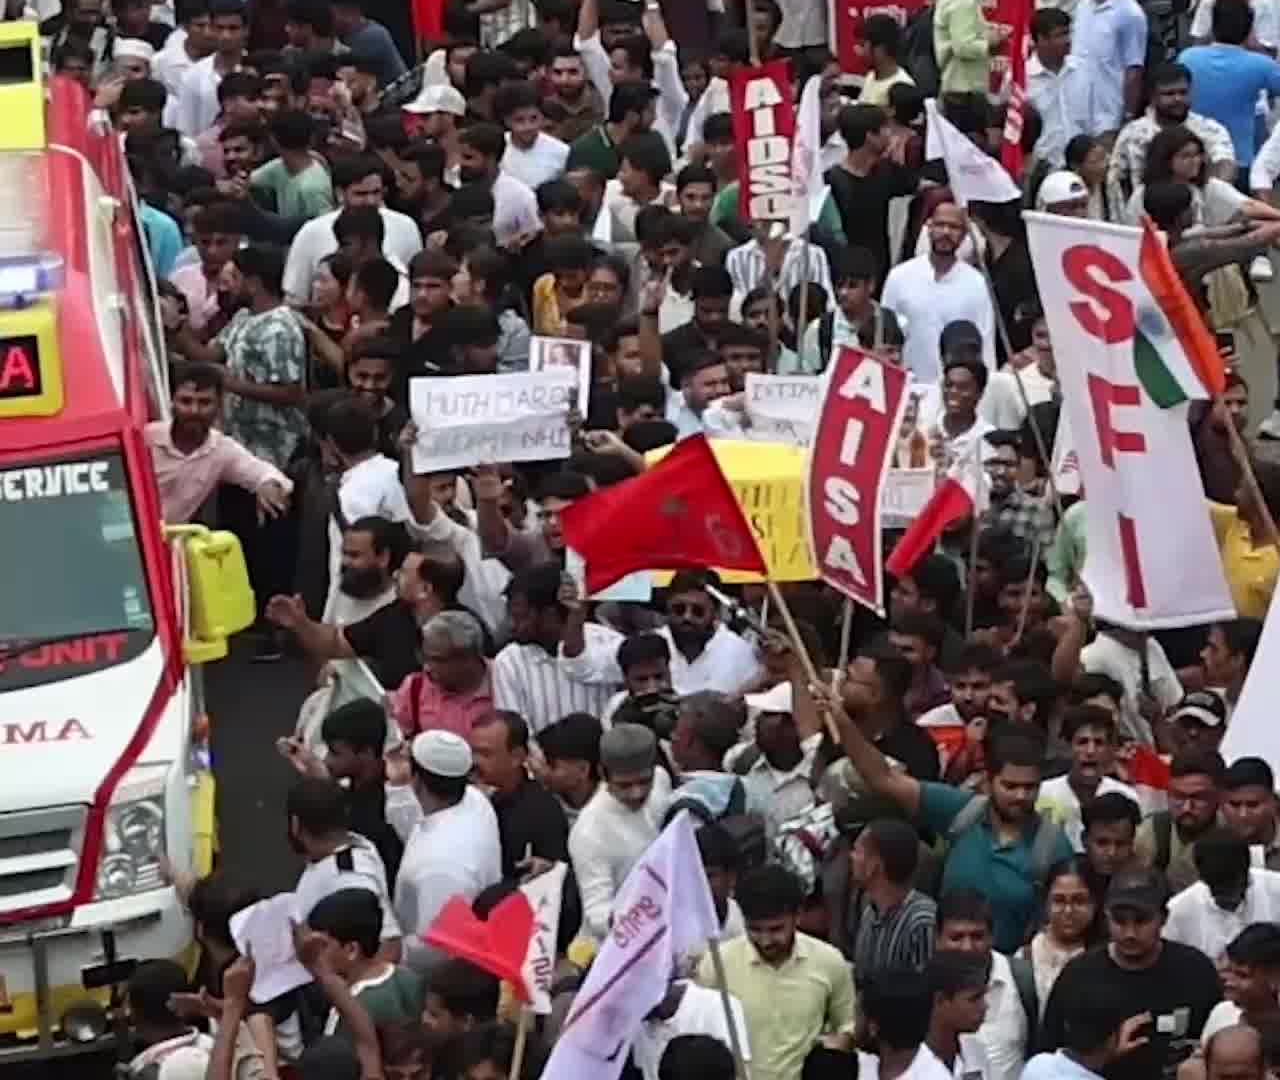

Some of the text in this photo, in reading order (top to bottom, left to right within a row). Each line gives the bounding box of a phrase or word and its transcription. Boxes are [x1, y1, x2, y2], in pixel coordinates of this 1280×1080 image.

[743, 77, 791, 219] AIDSO
[824, 357, 887, 588] AISA
[1061, 244, 1149, 611] SFI
